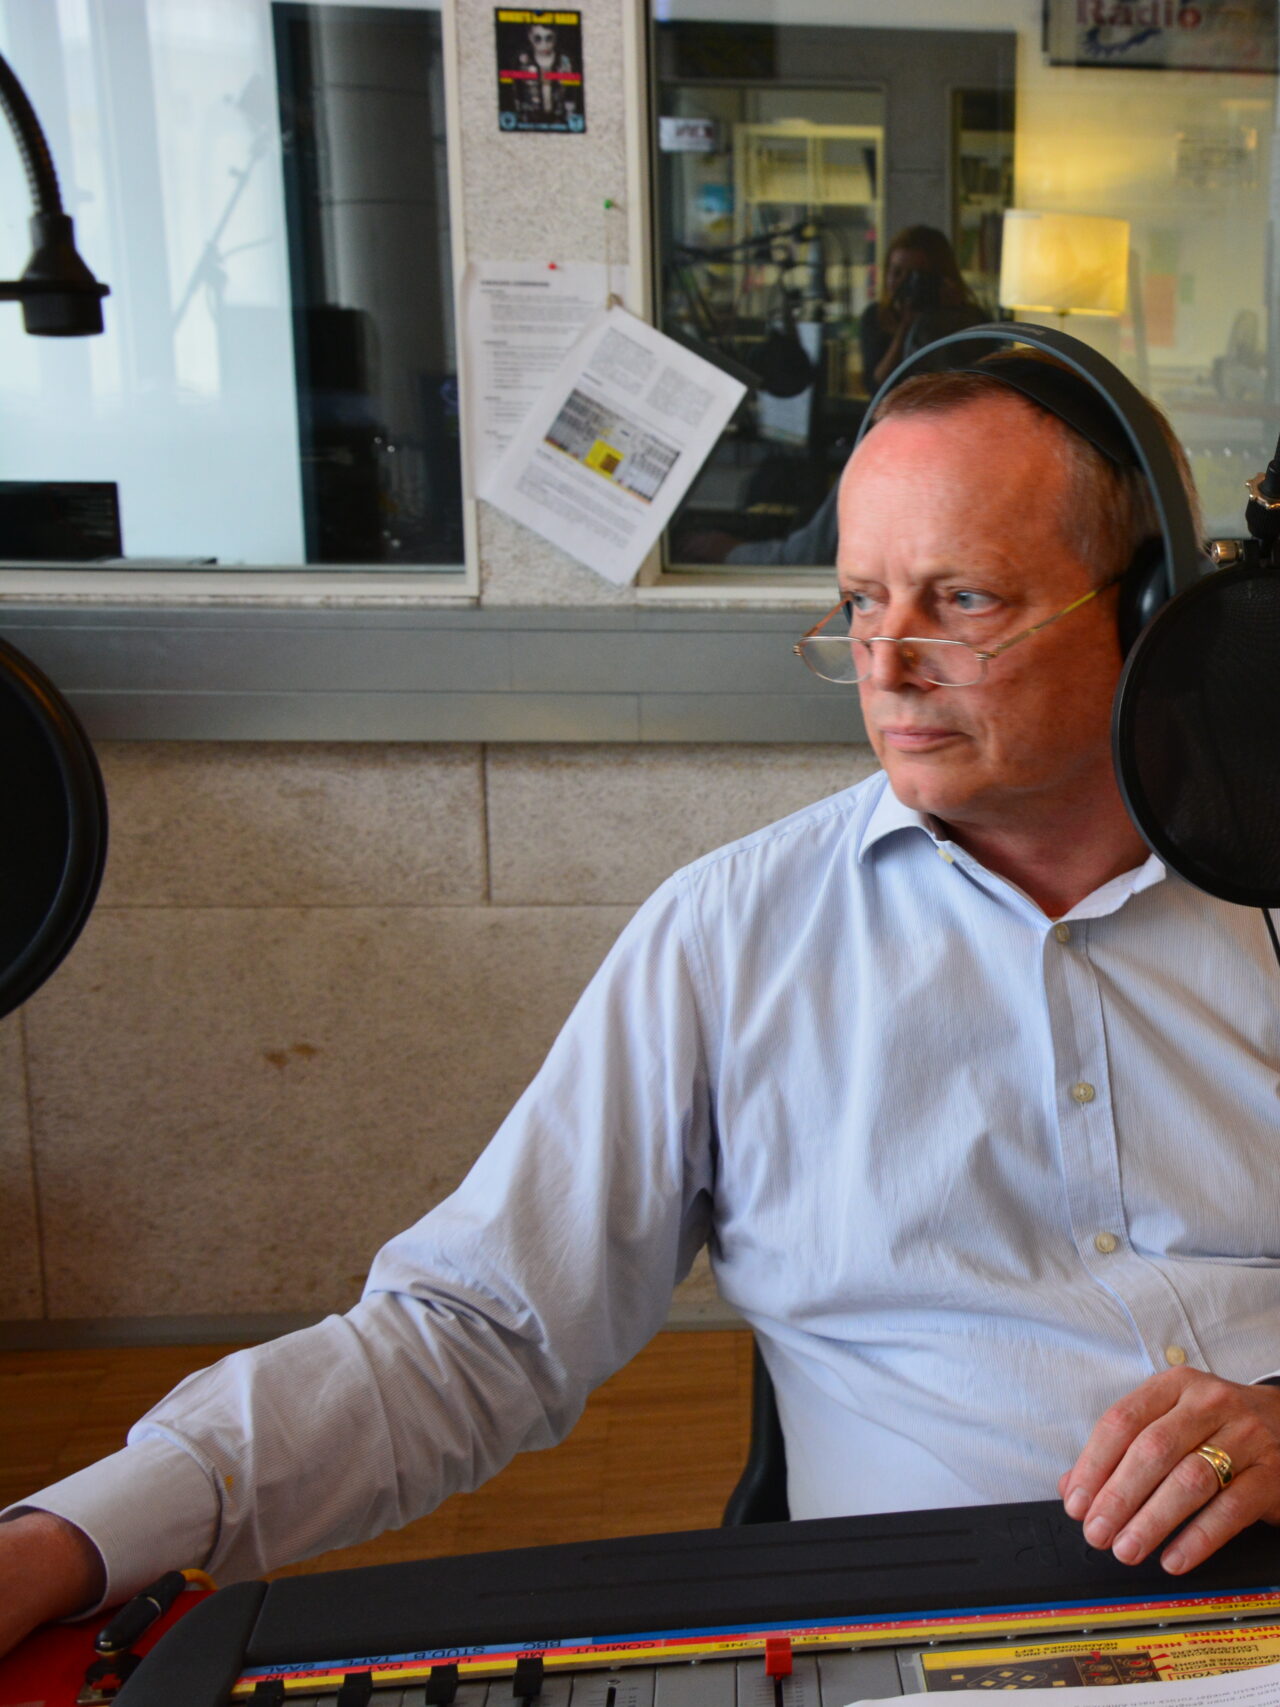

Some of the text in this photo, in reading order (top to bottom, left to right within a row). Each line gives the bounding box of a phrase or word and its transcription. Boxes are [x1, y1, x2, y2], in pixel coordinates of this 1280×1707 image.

[1183, 1629, 1234, 1639] HERE!
[522, 1640, 562, 1650] BBC
[1135, 1640, 1183, 1651] HIER!
[341, 1656, 391, 1667] TAPE
[263, 1663, 316, 1675] SAAL
[368, 1663, 405, 1673] DAT
[1176, 1671, 1215, 1680] YOU!
